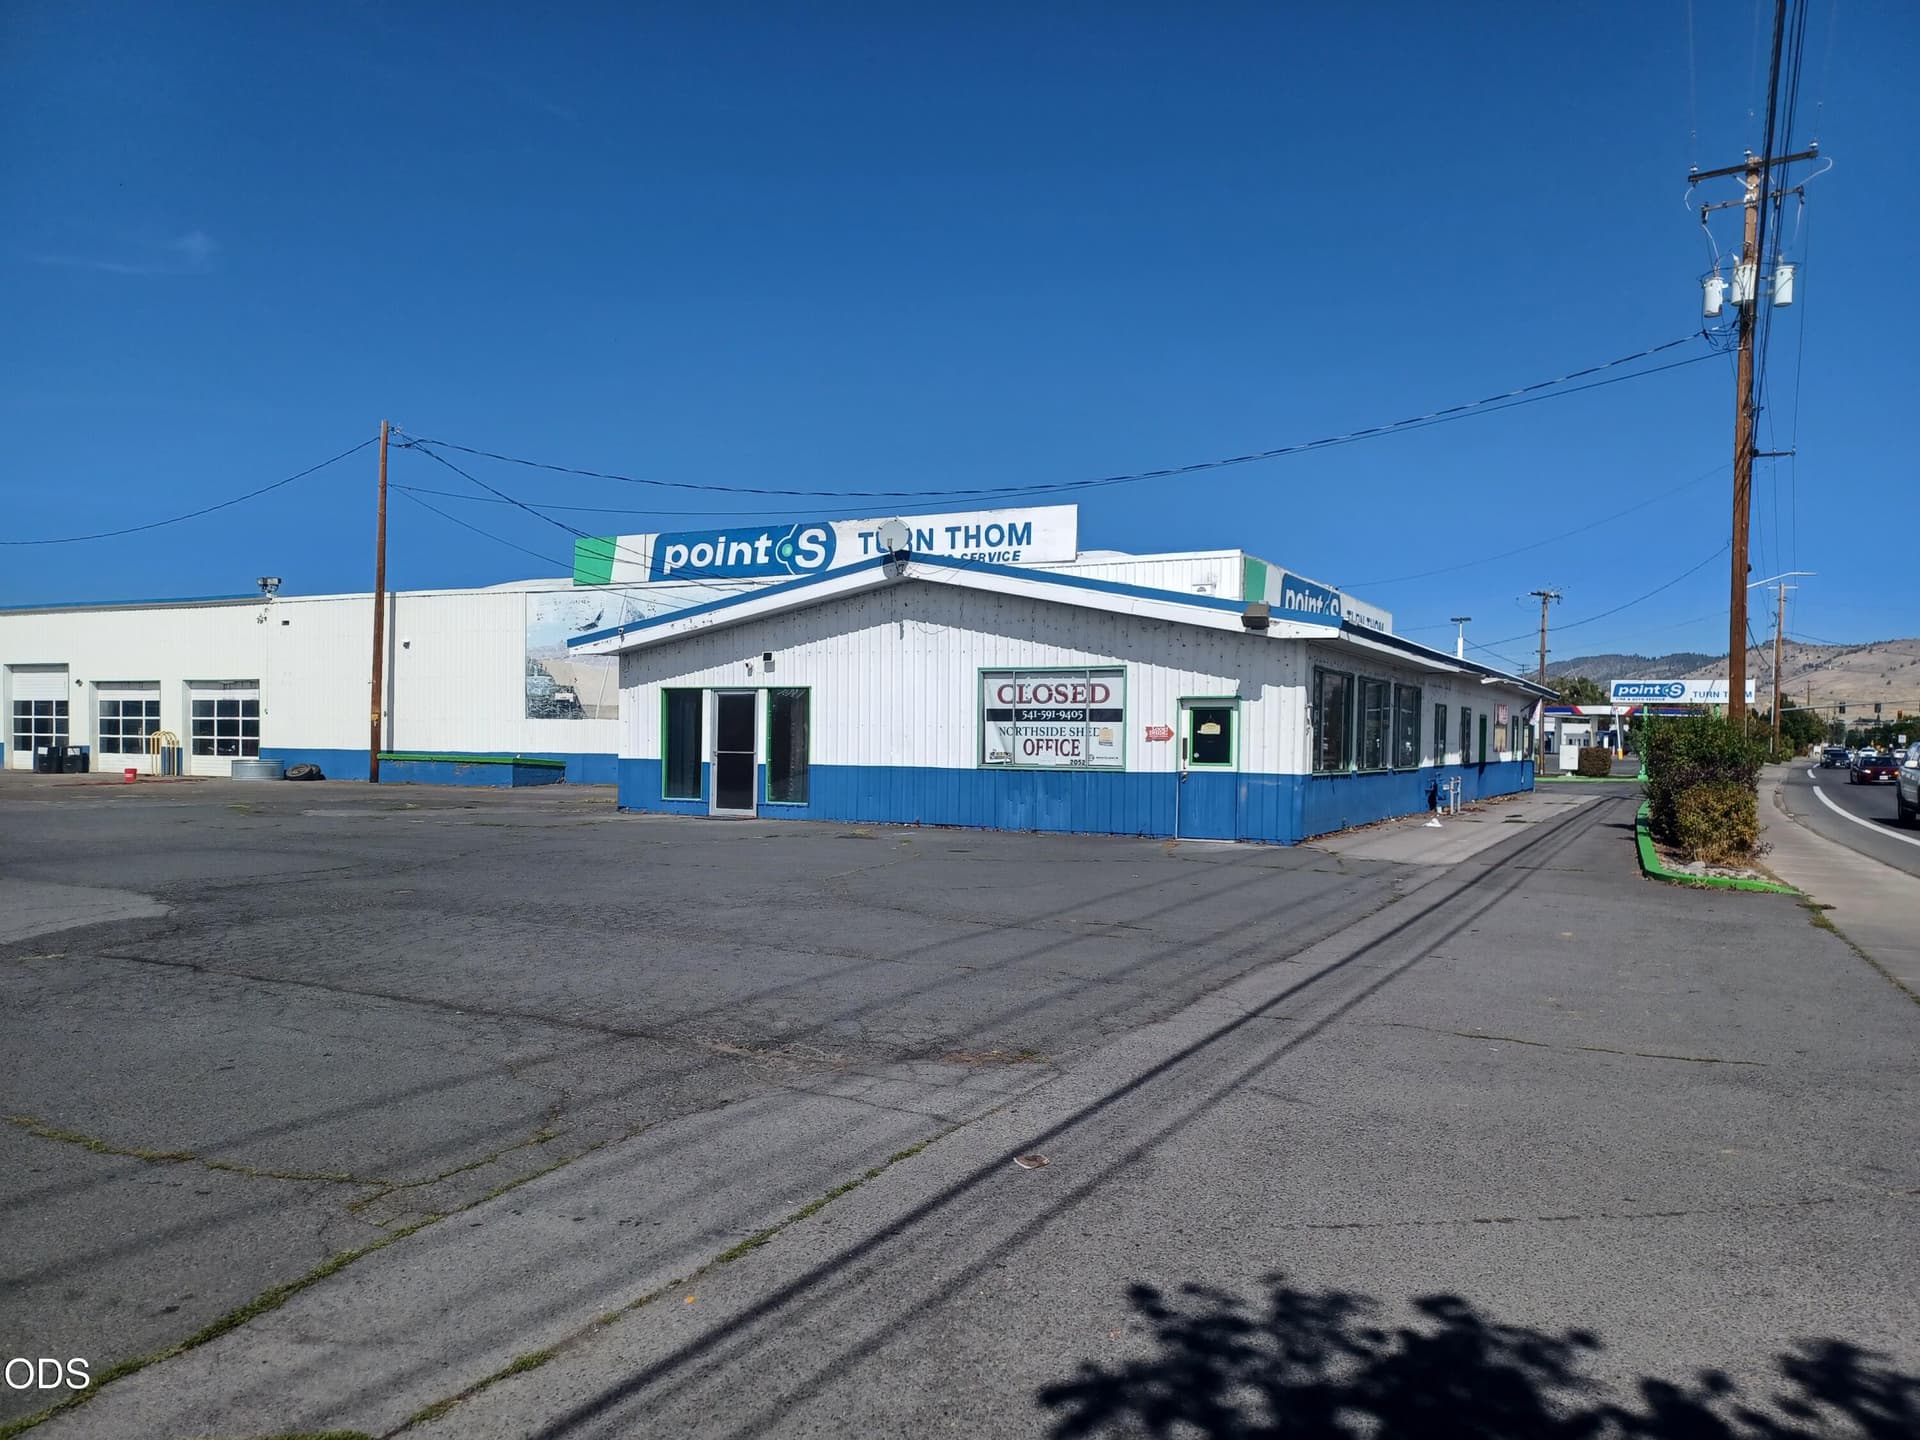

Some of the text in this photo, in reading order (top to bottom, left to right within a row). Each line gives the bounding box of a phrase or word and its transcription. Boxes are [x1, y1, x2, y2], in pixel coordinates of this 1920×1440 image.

[857, 521, 1033, 555] TN THOM
[662, 528, 828, 576] point S
[996, 682, 1111, 705] CLOSED
[1618, 683, 1683, 697] point S
[1692, 690, 1753, 699] TURN TM
[1021, 709, 1084, 721] 541-591-9405
[998, 726, 1109, 738] NORTHSIDE SHED
[1022, 737, 1081, 757] OFFICE
